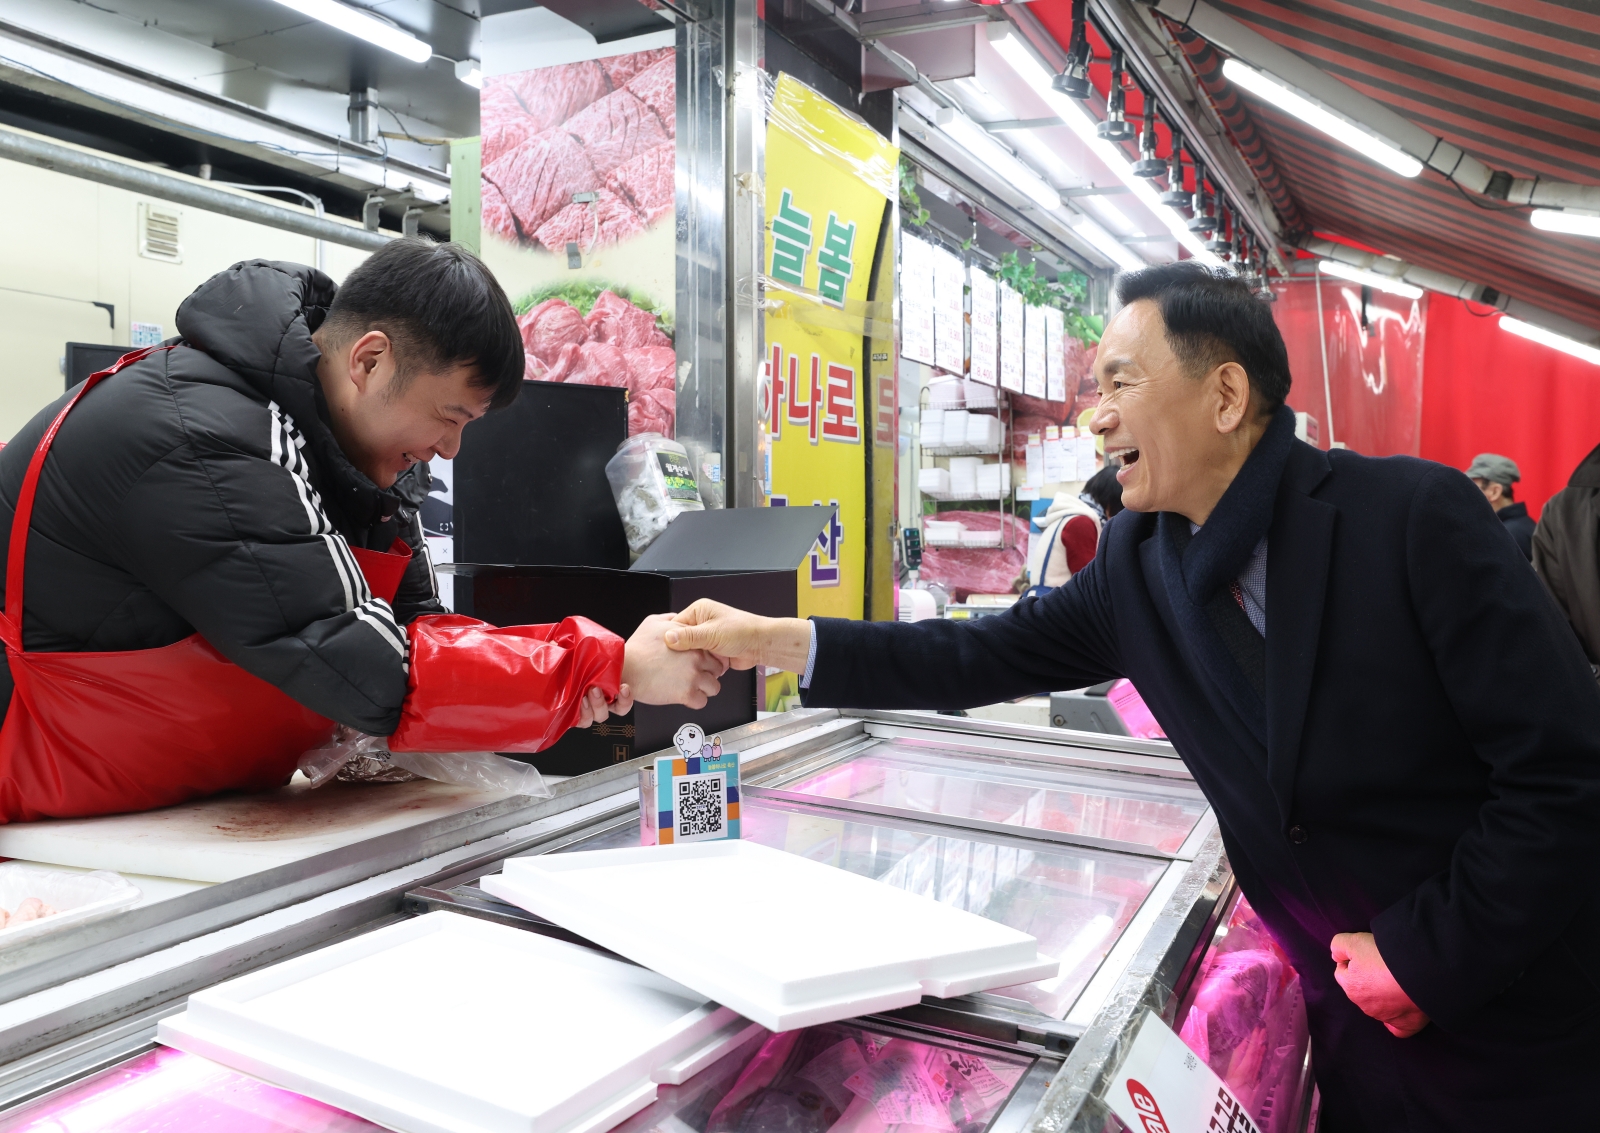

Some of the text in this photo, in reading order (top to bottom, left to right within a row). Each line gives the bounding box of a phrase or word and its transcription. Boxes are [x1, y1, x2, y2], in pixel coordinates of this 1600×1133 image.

[770, 188, 856, 307] 늘봄
[765, 343, 859, 442] 하나로
[616, 746, 627, 761] H
